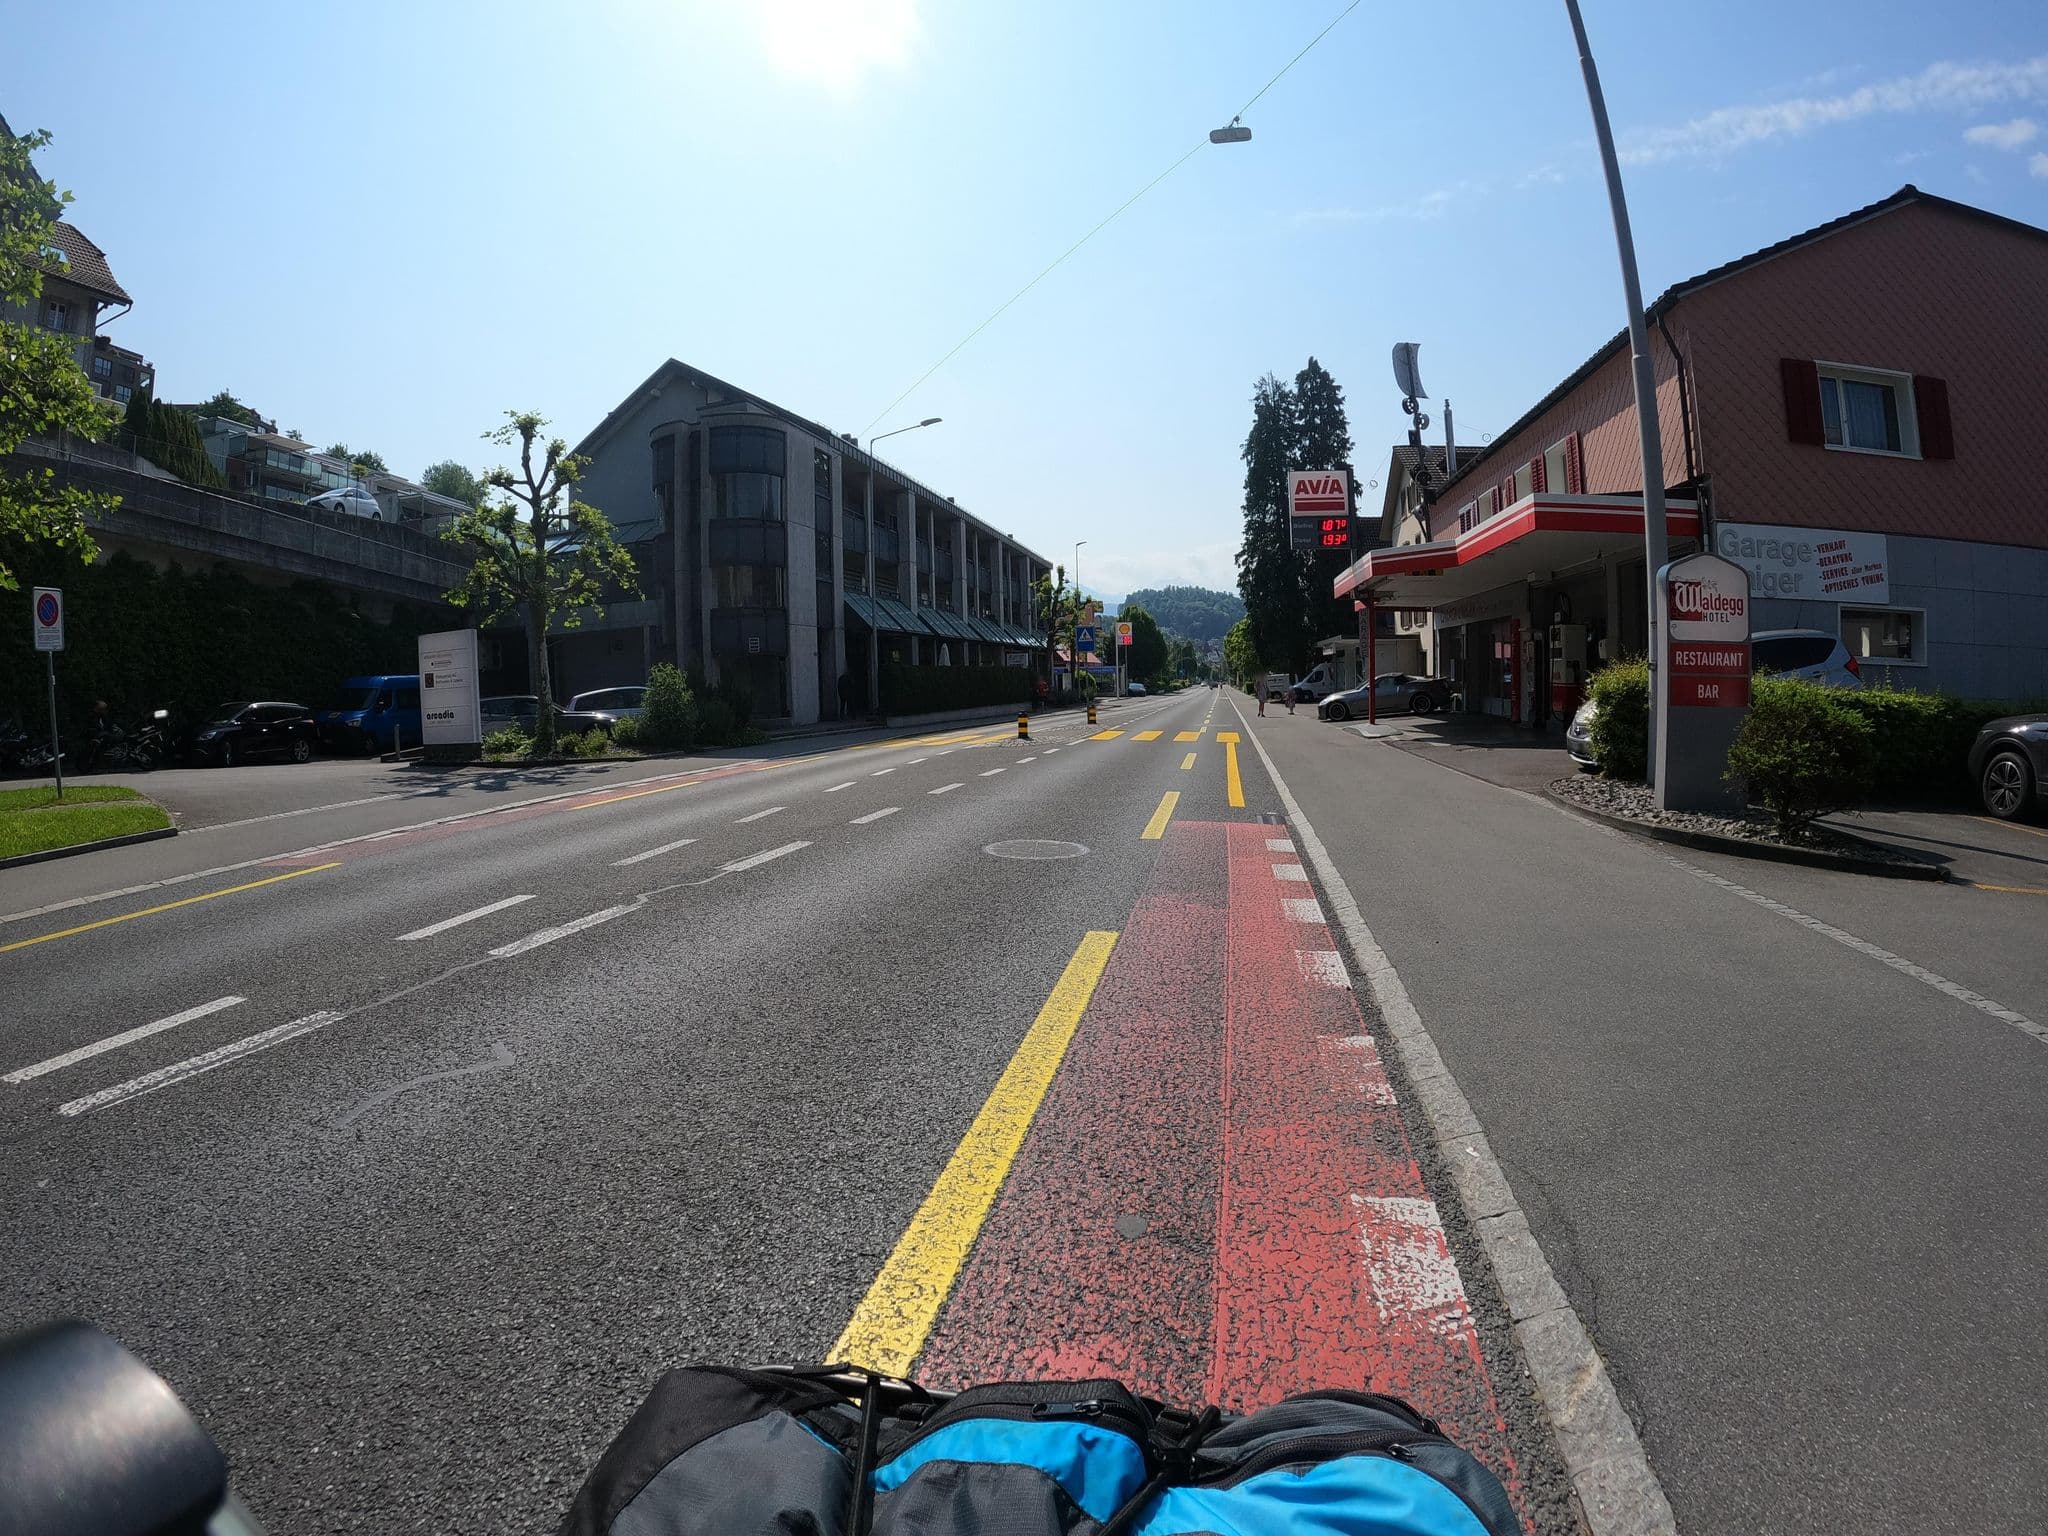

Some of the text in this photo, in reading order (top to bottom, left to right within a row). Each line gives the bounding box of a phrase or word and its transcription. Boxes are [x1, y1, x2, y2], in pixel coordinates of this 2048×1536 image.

[1719, 529, 1813, 567] Garage
[1674, 582, 1744, 616] Waldegg
[1702, 612, 1730, 623] HOTEL
[1675, 651, 1744, 667] RESTAURANT
[1697, 684, 1719, 699] BAR
[426, 710, 455, 720] arcadia
